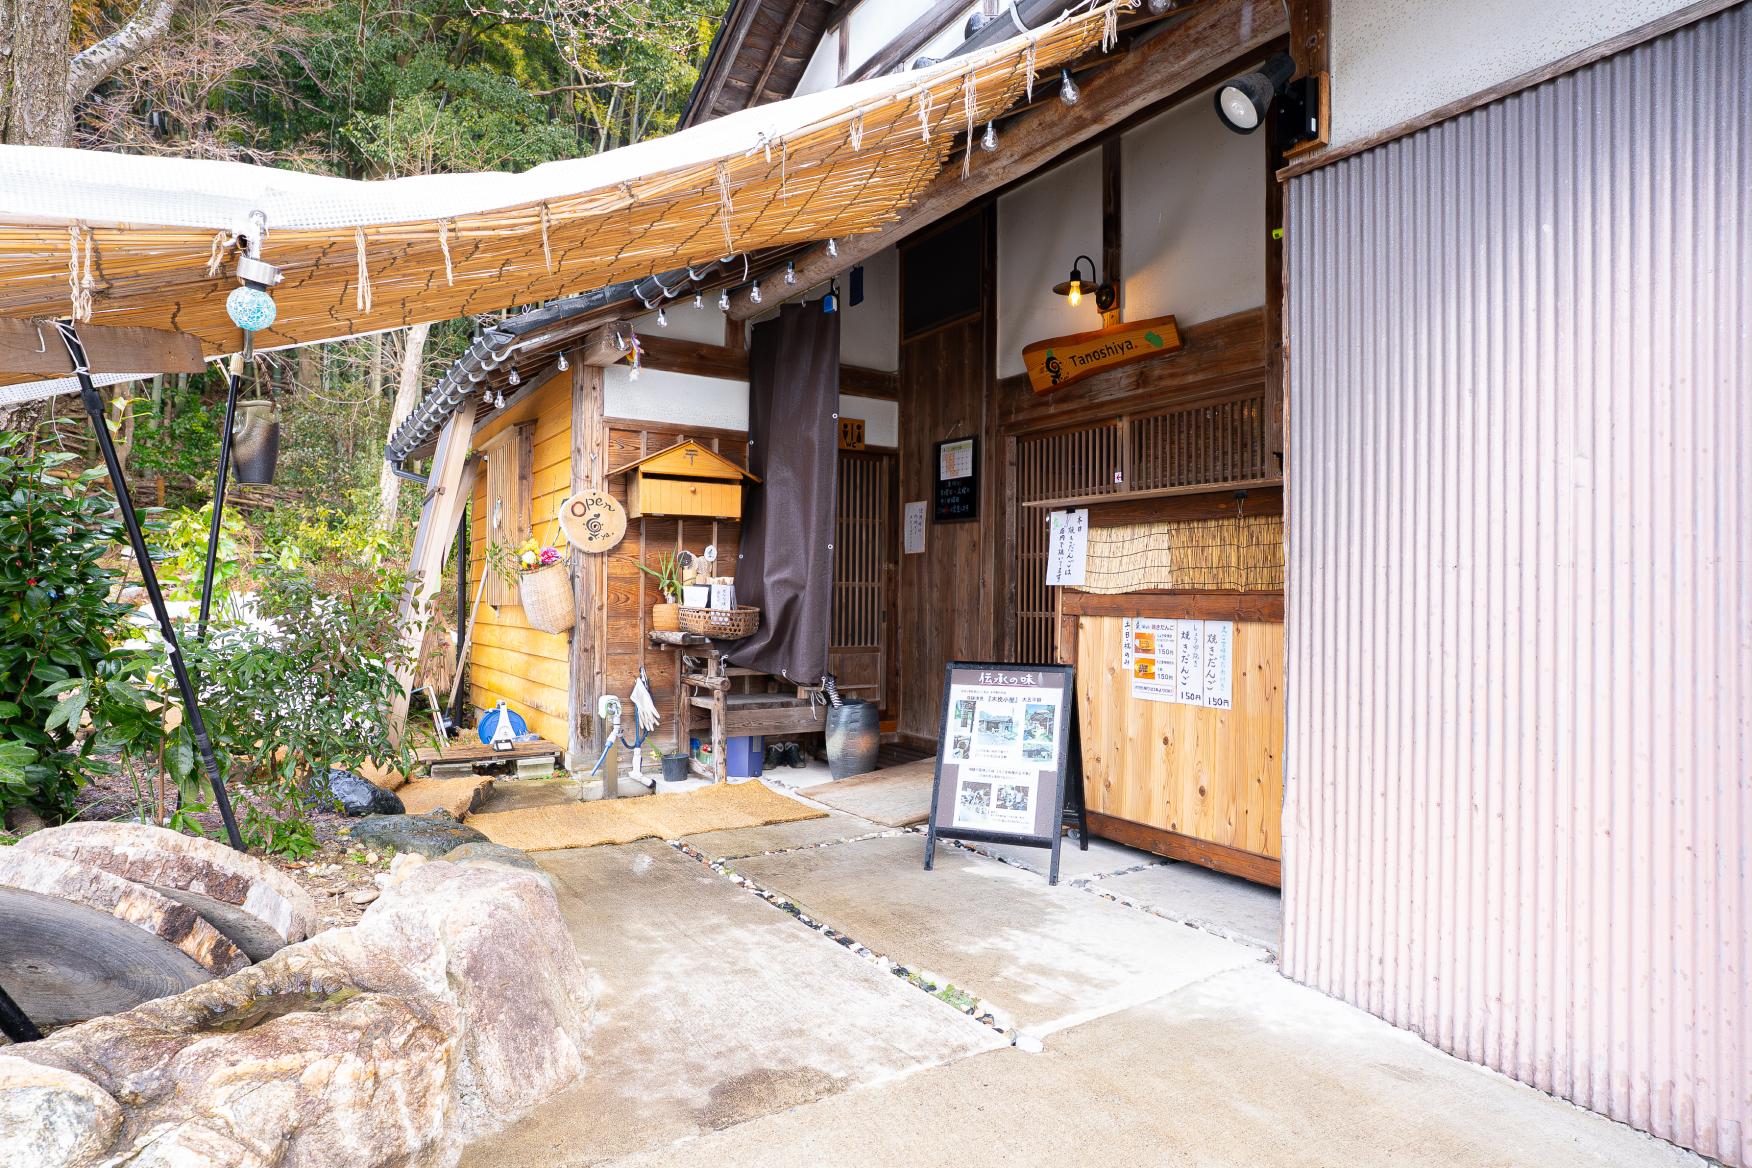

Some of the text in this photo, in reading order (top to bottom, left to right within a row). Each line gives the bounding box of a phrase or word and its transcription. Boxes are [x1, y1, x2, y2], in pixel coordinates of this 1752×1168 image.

[846, 441, 857, 449] WC
[571, 498, 616, 517] Open
[1077, 515, 1083, 532] 本日
[1158, 648, 1174, 656] 150円
[1180, 630, 1191, 686] 焼きだんご
[1206, 633, 1218, 691] 焼きだんご
[978, 672, 1036, 686] 伝承の味
[1158, 673, 1174, 681] 150円
[1181, 691, 1201, 701] 150円
[1208, 696, 1230, 708] 150円
